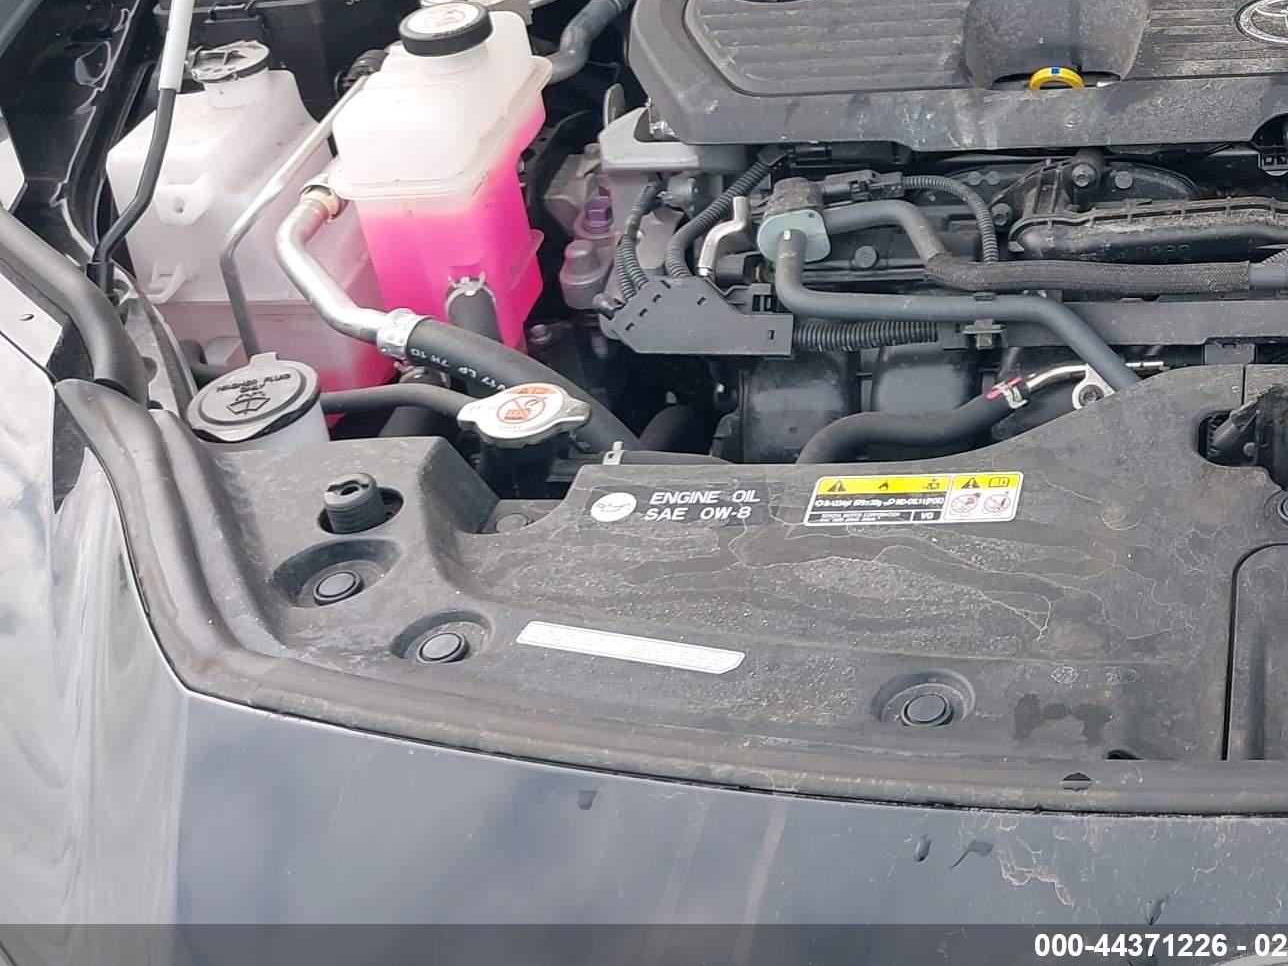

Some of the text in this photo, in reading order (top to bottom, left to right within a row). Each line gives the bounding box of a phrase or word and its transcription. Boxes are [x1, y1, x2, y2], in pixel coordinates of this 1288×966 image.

[650, 489, 761, 505] ENGINE OIL
[644, 507, 688, 521] SAE
